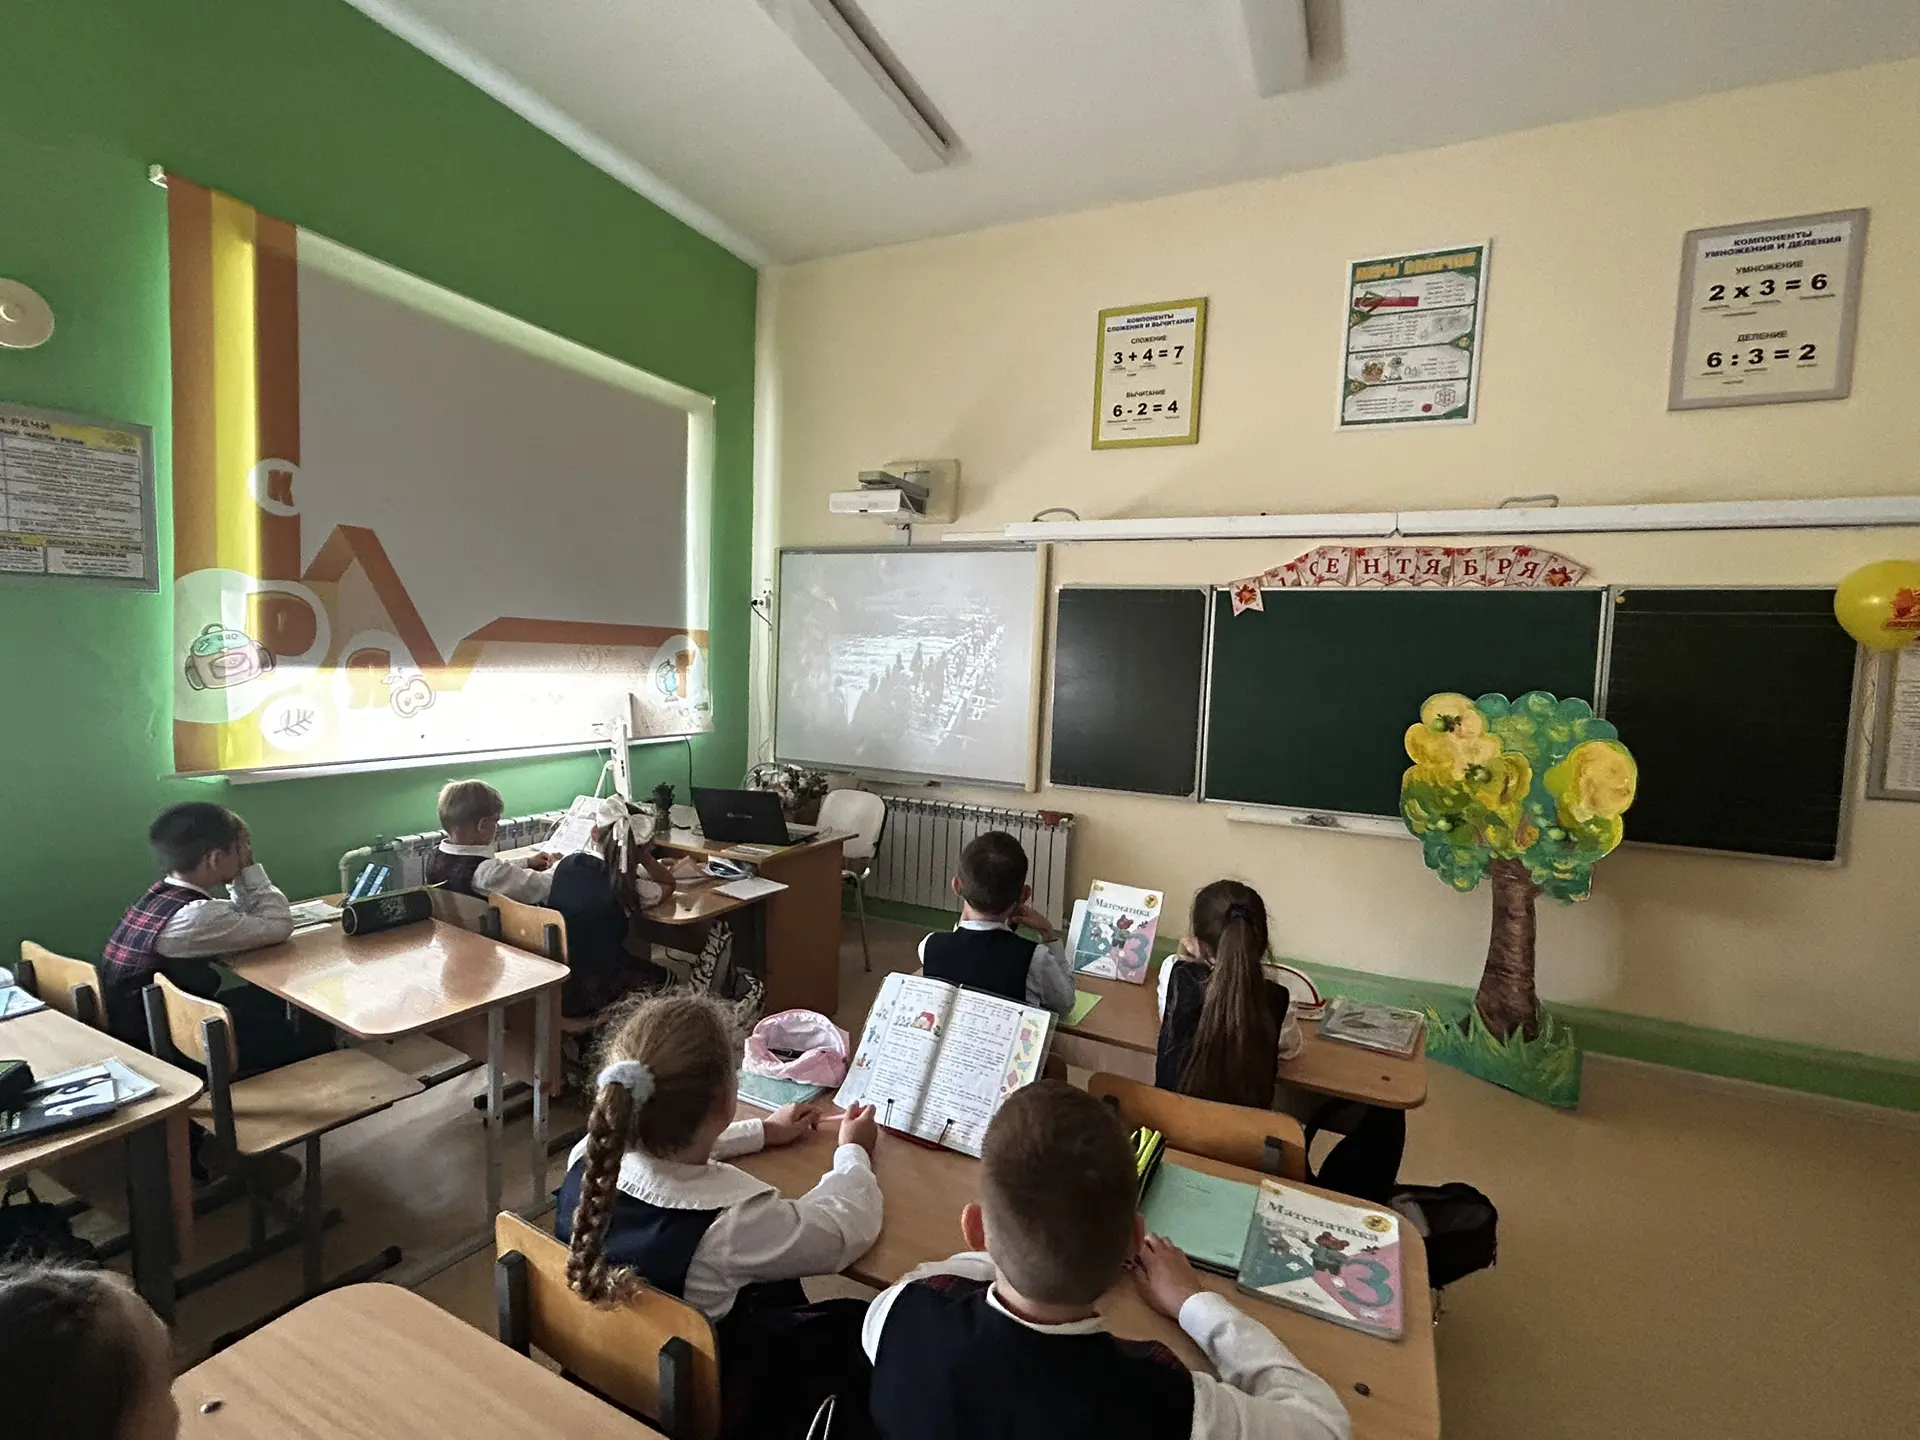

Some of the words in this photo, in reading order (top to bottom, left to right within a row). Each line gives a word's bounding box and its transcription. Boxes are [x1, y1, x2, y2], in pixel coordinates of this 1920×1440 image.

[1704, 244, 1774, 258] УМНОЖЕНИЯ
[1777, 242, 1785, 250] И
[1787, 236, 1842, 249] ДЕЛЕНИЯ
[1733, 231, 1812, 246] КОМПОНЕНТЫ
[1735, 260, 1804, 275] УМНОЖЕНИЕ
[1708, 285, 1725, 301] 2
[1759, 279, 1775, 296] 3
[1785, 279, 1801, 290] =
[1811, 273, 1827, 290] 6
[1107, 324, 1143, 332] СЛОЖЕНИЯ
[1152, 317, 1194, 327] ВЫЧИТАНИЯ
[1126, 313, 1174, 324] КОМПОНЕНТЫ
[1130, 335, 1167, 344] СЛОЖЕНИЕ
[1737, 330, 1788, 342] ДЕЛЕНИЕ
[1113, 352, 1123, 364] 3
[1128, 352, 1137, 361] +
[1142, 348, 1153, 361] 4
[1158, 349, 1168, 357] =
[1174, 345, 1184, 358] 7
[1706, 351, 1722, 368] 6
[1748, 348, 1764, 364] 3
[1774, 349, 1790, 359] =
[1798, 343, 1816, 360] 2
[1126, 389, 1166, 398] ВЫЧИТАНИЕ
[1112, 404, 1123, 417] 6
[1137, 402, 1147, 415] 2
[1153, 404, 1162, 412] =
[1167, 400, 1178, 413] 4
[1309, 557, 1540, 579] СЕНТЯБРЯ
[1096, 898, 1150, 917] Математика
[1268, 1201, 1380, 1243] Математика
[1339, 1258, 1395, 1307] 3
